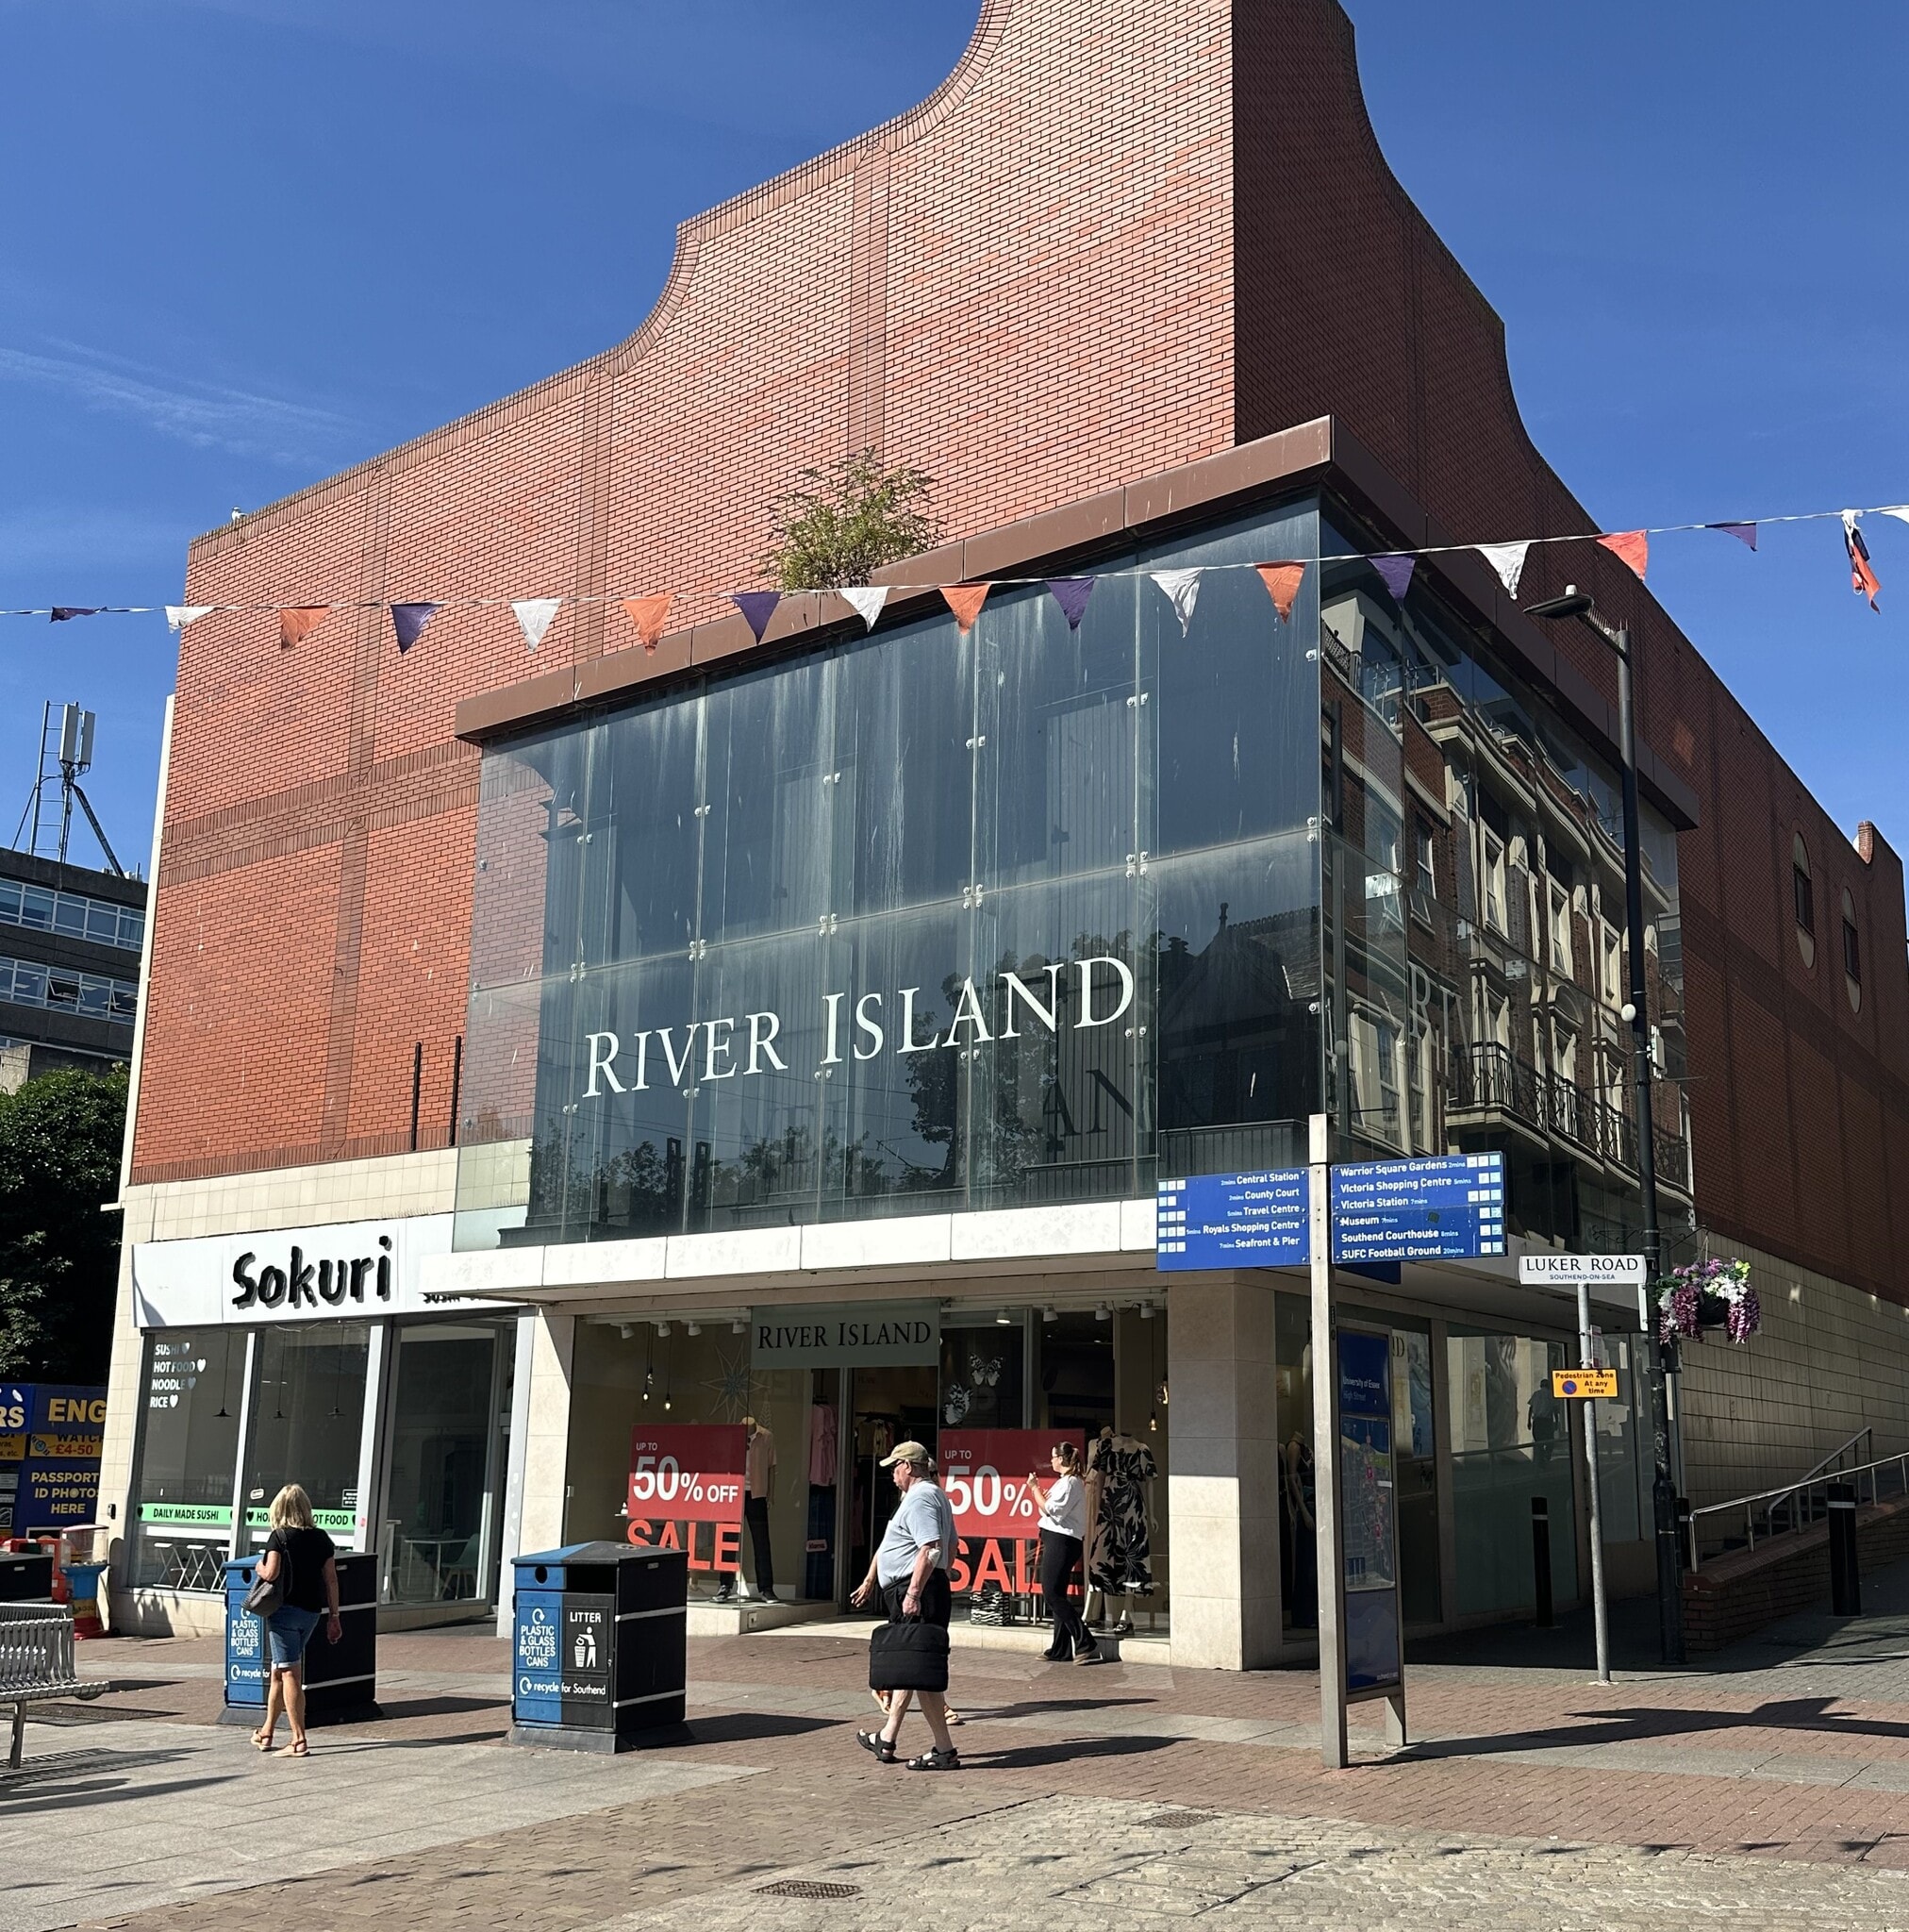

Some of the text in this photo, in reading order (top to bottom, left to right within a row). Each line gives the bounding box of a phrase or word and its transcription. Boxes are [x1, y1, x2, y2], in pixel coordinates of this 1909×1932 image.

[581, 955, 1135, 1099] RIVER ISLAND
[1340, 1167, 1374, 1177] Warrior
[1375, 1164, 1407, 1175] Square
[1408, 1160, 1448, 1172] Gardens
[1237, 1174, 1268, 1185] Central
[1269, 1173, 1300, 1182] Station
[1340, 1182, 1374, 1193] Victoria
[1376, 1179, 1419, 1191] Shopping
[1419, 1176, 1452, 1188] Centre
[1244, 1190, 1274, 1200] County
[1275, 1188, 1300, 1198] Court
[1340, 1199, 1375, 1209] Victoria
[1376, 1196, 1409, 1208] Station
[1242, 1206, 1270, 1216] Travel
[1270, 1204, 1301, 1214] Centre
[1341, 1216, 1380, 1226] Museum
[1203, 1224, 1230, 1236] Royals
[1231, 1223, 1270, 1234] Shopping
[1270, 1221, 1301, 1230] Centre
[1341, 1231, 1385, 1243] Southend
[1385, 1228, 1439, 1240] Courthouse
[1235, 1238, 1271, 1248] Seafront
[1272, 1237, 1280, 1246] &
[1282, 1236, 1301, 1246] Pier
[1341, 1248, 1367, 1259] SUFC
[1368, 1246, 1405, 1258] Football
[1406, 1244, 1441, 1257] Ground
[1525, 1257, 1638, 1272] LUKER ROAD
[231, 1235, 392, 1309] Sokuri
[757, 1321, 931, 1349] RIVER ISLAND
[155, 1343, 180, 1356] SUSHI
[153, 1360, 196, 1373] HOT FOOD
[151, 1378, 186, 1391] NOODLE
[149, 1395, 169, 1408] RICE
[58, 1434, 103, 1442] WATC
[56, 1444, 92, 1456] £4-50
[636, 1442, 658, 1451] UP TO
[944, 1450, 971, 1459] UP TO
[31, 1472, 99, 1484] PASSPORT
[633, 1456, 739, 1504] 50% OFF
[35, 1488, 48, 1499] ID
[51, 1503, 86, 1514] HERE
[153, 1508, 219, 1521] DAILY MADE SUSHI
[324, 1514, 349, 1525] FOOD
[950, 1539, 1082, 1595] SAL
[569, 1611, 602, 1623] LITTER
[231, 1619, 258, 1629] PLASTIC
[520, 1625, 555, 1635] PLASTIC
[231, 1628, 258, 1638] & GLASS
[230, 1638, 259, 1647] BOTTLES
[520, 1636, 556, 1646] & GLASS
[236, 1646, 254, 1657] CANS
[519, 1646, 556, 1657] BOTTLES
[526, 1657, 549, 1667] CANS
[241, 1668, 261, 1679] recycle
[533, 1681, 606, 1695] recycle for Southend
